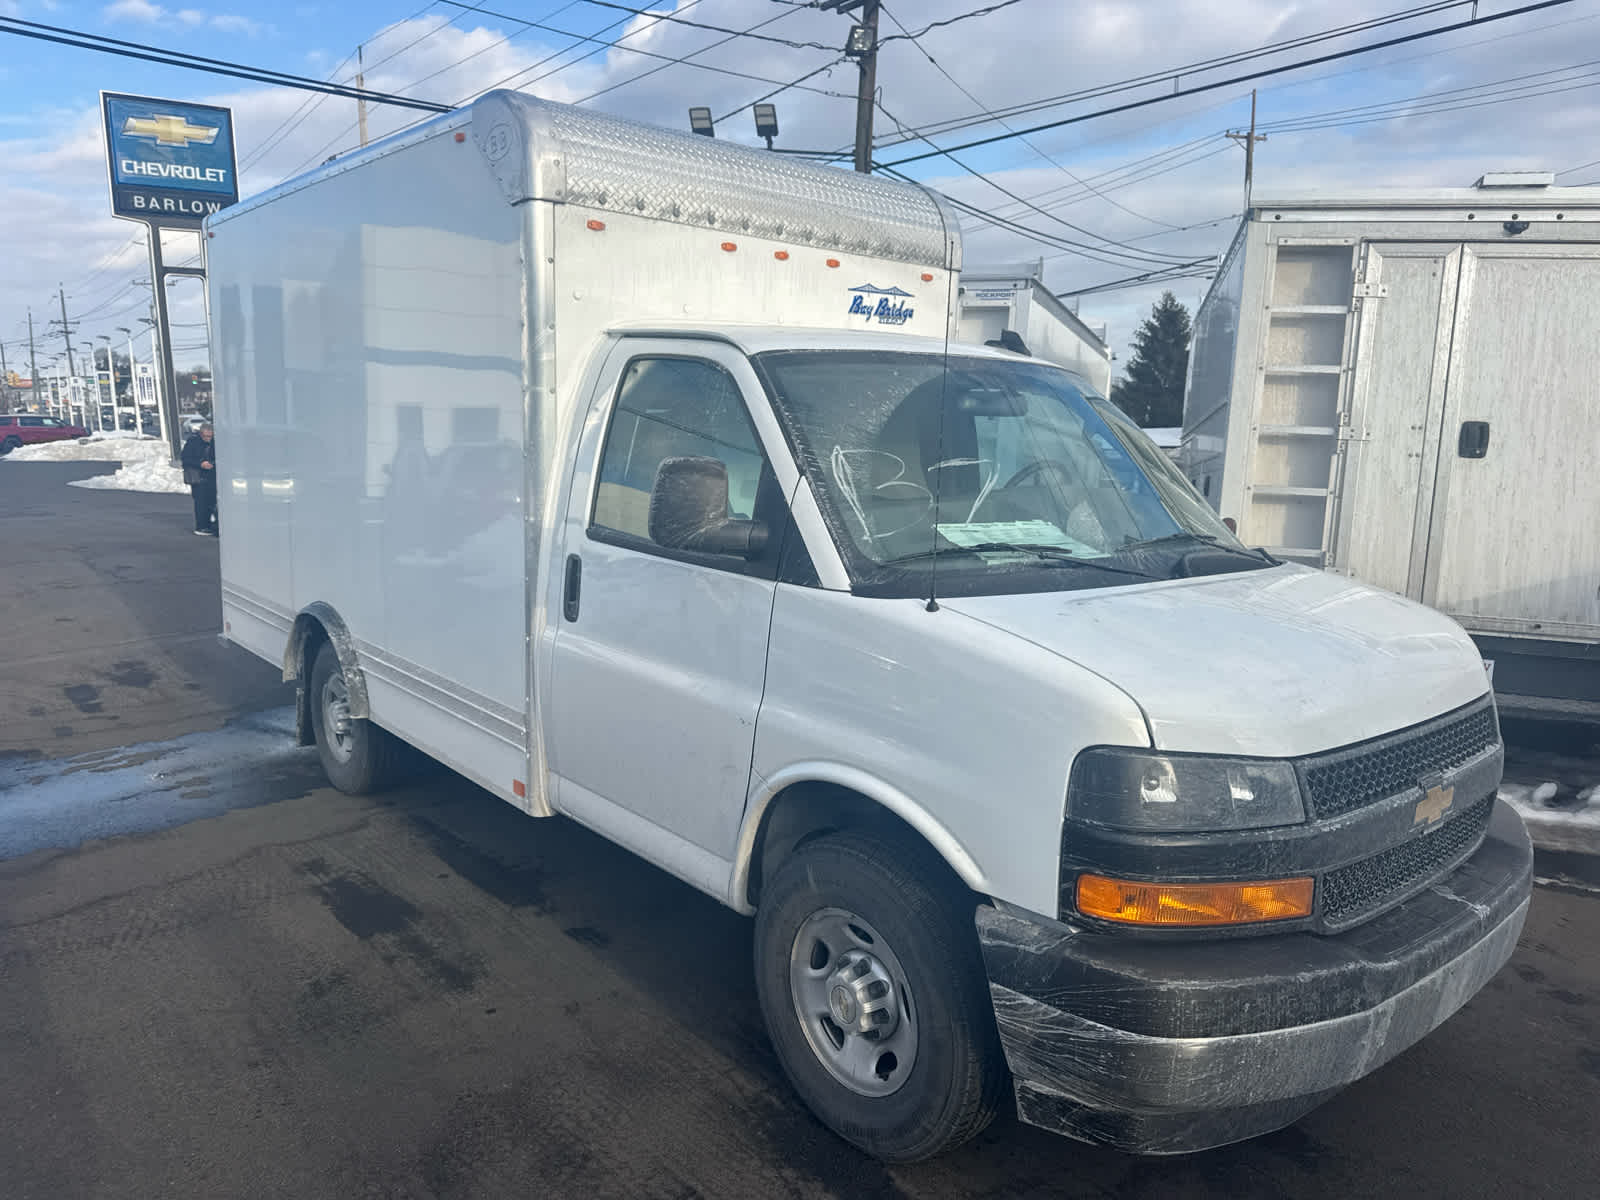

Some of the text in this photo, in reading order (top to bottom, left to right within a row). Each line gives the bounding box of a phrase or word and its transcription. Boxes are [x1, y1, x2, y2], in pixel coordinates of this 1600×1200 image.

[121, 159, 227, 183] CHEVROLET
[133, 195, 221, 214] BARLOW
[847, 294, 915, 324] Bay Bridge
